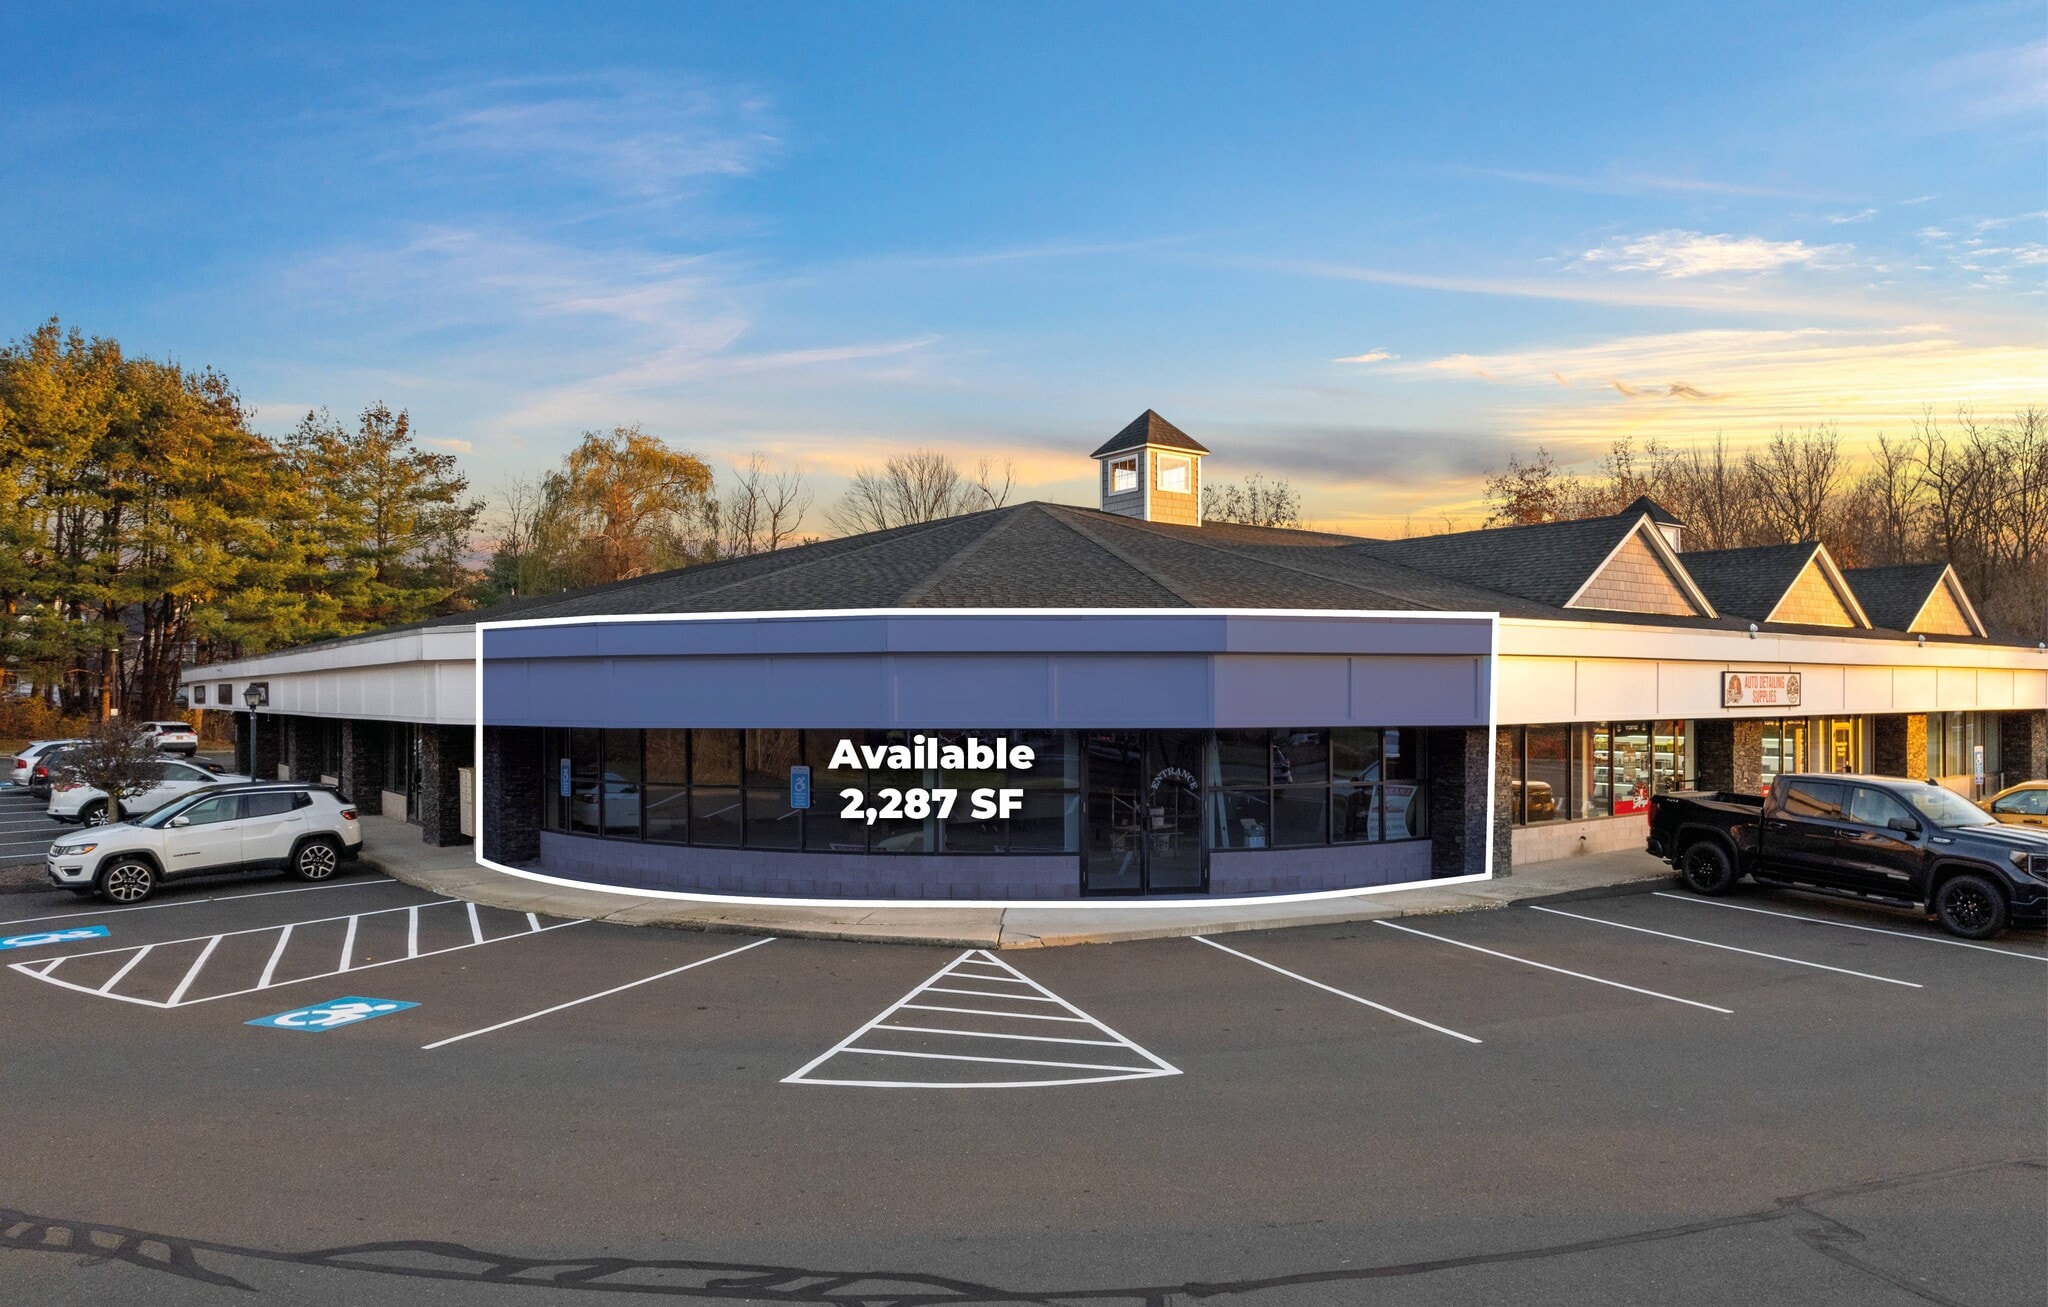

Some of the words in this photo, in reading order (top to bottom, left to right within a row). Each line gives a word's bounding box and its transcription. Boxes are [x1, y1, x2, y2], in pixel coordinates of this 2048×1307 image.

[1744, 675, 1758, 688] AUTO
[1759, 675, 1784, 688] DETAILING
[1752, 690, 1776, 703] SUPPLIES
[1151, 767, 1198, 790] ENTRANCE
